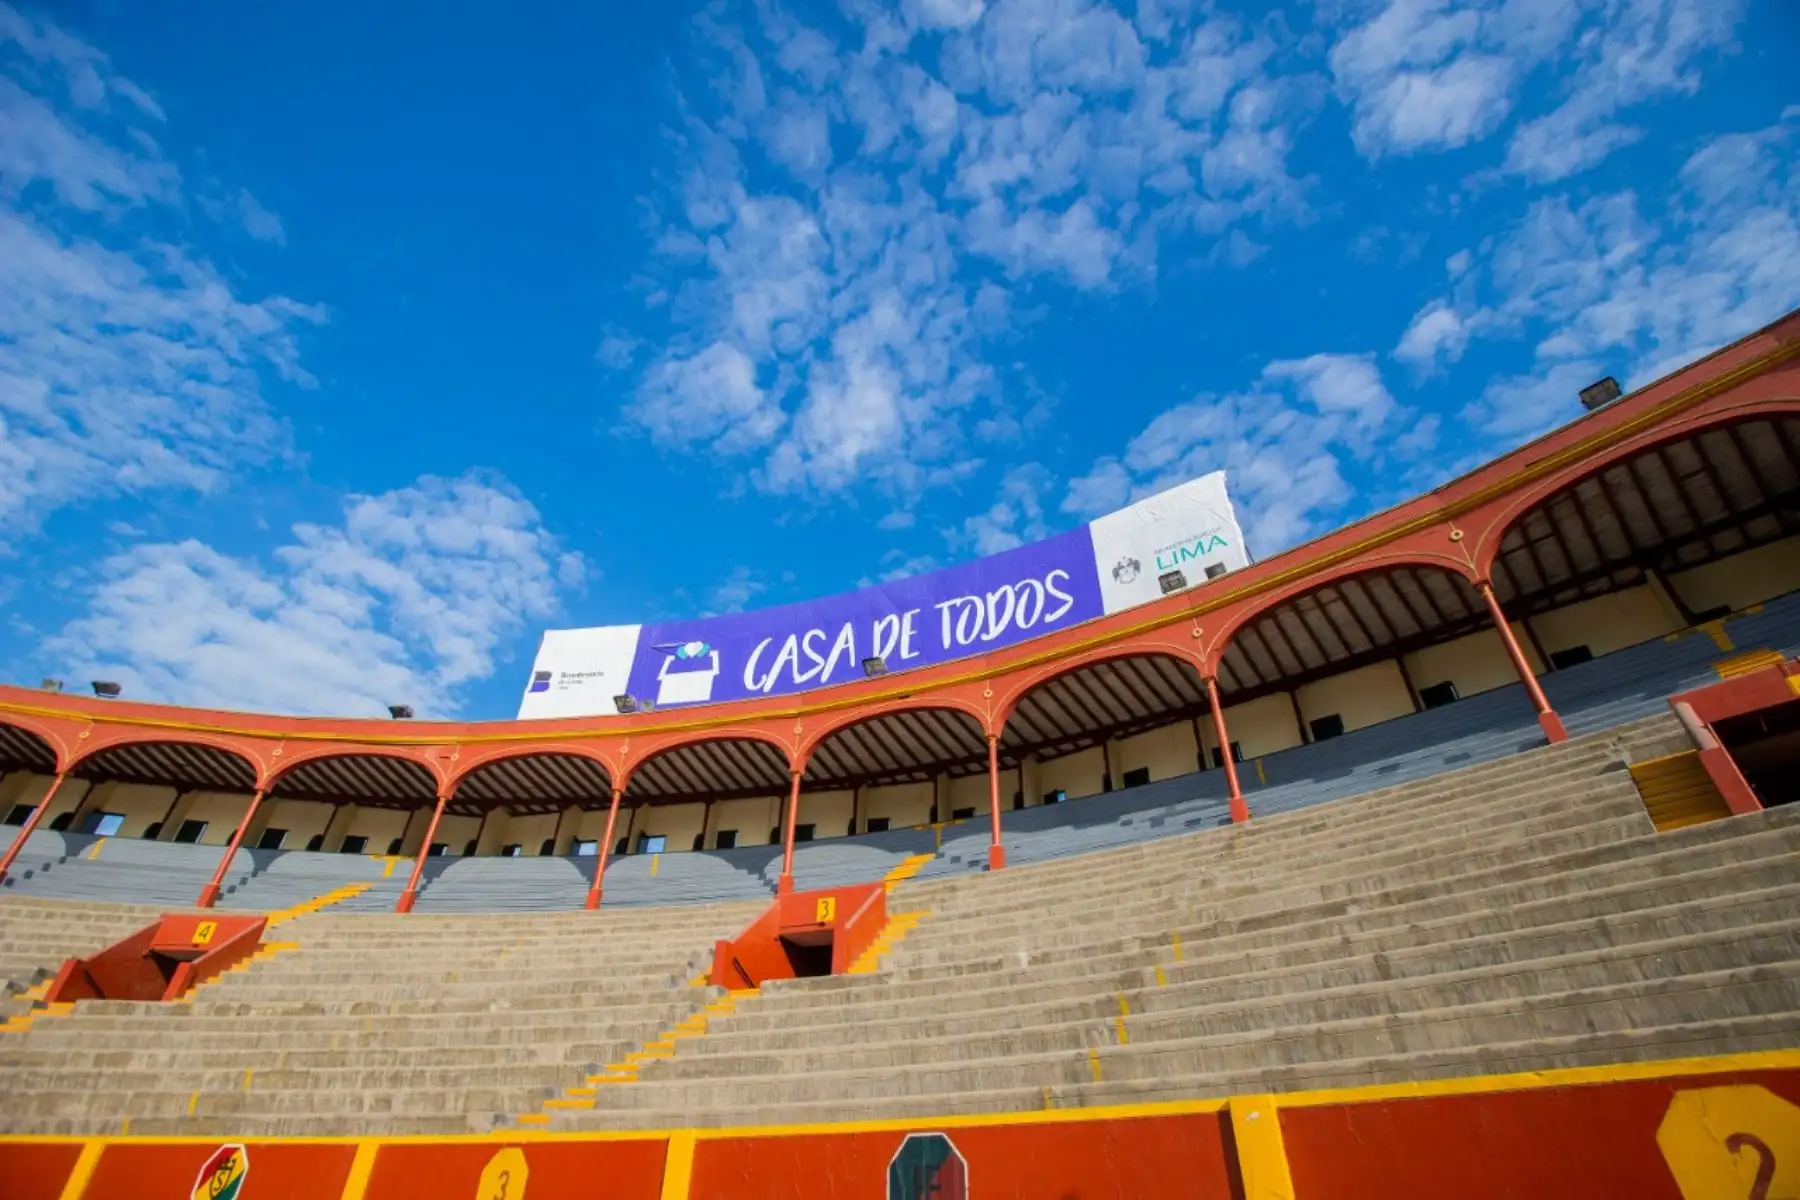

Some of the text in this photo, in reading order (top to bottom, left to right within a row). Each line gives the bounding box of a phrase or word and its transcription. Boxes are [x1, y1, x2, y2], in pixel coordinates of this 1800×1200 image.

[1156, 535, 1229, 570] LIMA
[743, 569, 1075, 693] CASA DE TODOS
[198, 924, 212, 941] 4
[492, 1169, 511, 1200] 3
